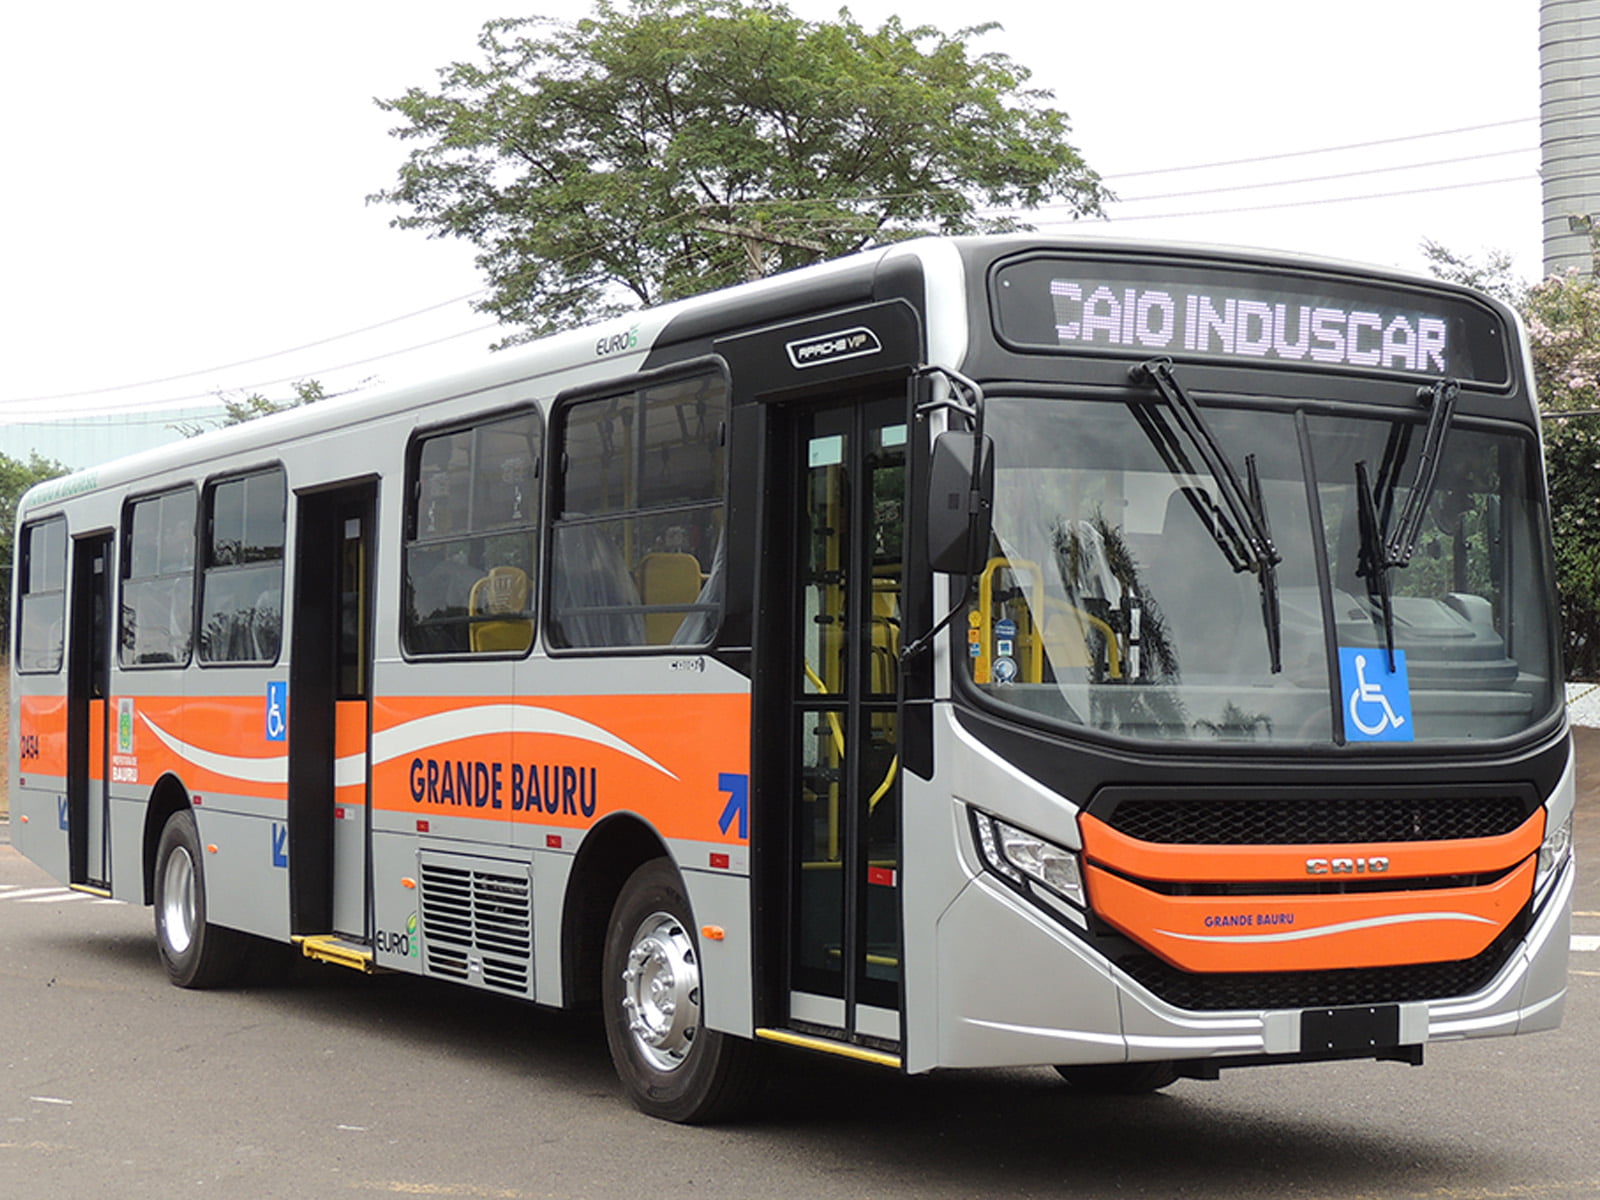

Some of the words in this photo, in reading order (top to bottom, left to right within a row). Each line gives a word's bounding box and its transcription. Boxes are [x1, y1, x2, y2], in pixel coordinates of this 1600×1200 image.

[1050, 278, 1175, 347] CAIO
[1184, 294, 1447, 373] INDUSCAR
[410, 757, 503, 809] GRANDE
[511, 763, 597, 818] BAURU
[1306, 856, 1389, 874] CAIO
[1204, 914, 1254, 928] GRANDE
[1256, 913, 1295, 926] BAURU
[376, 929, 419, 958] EURO6
